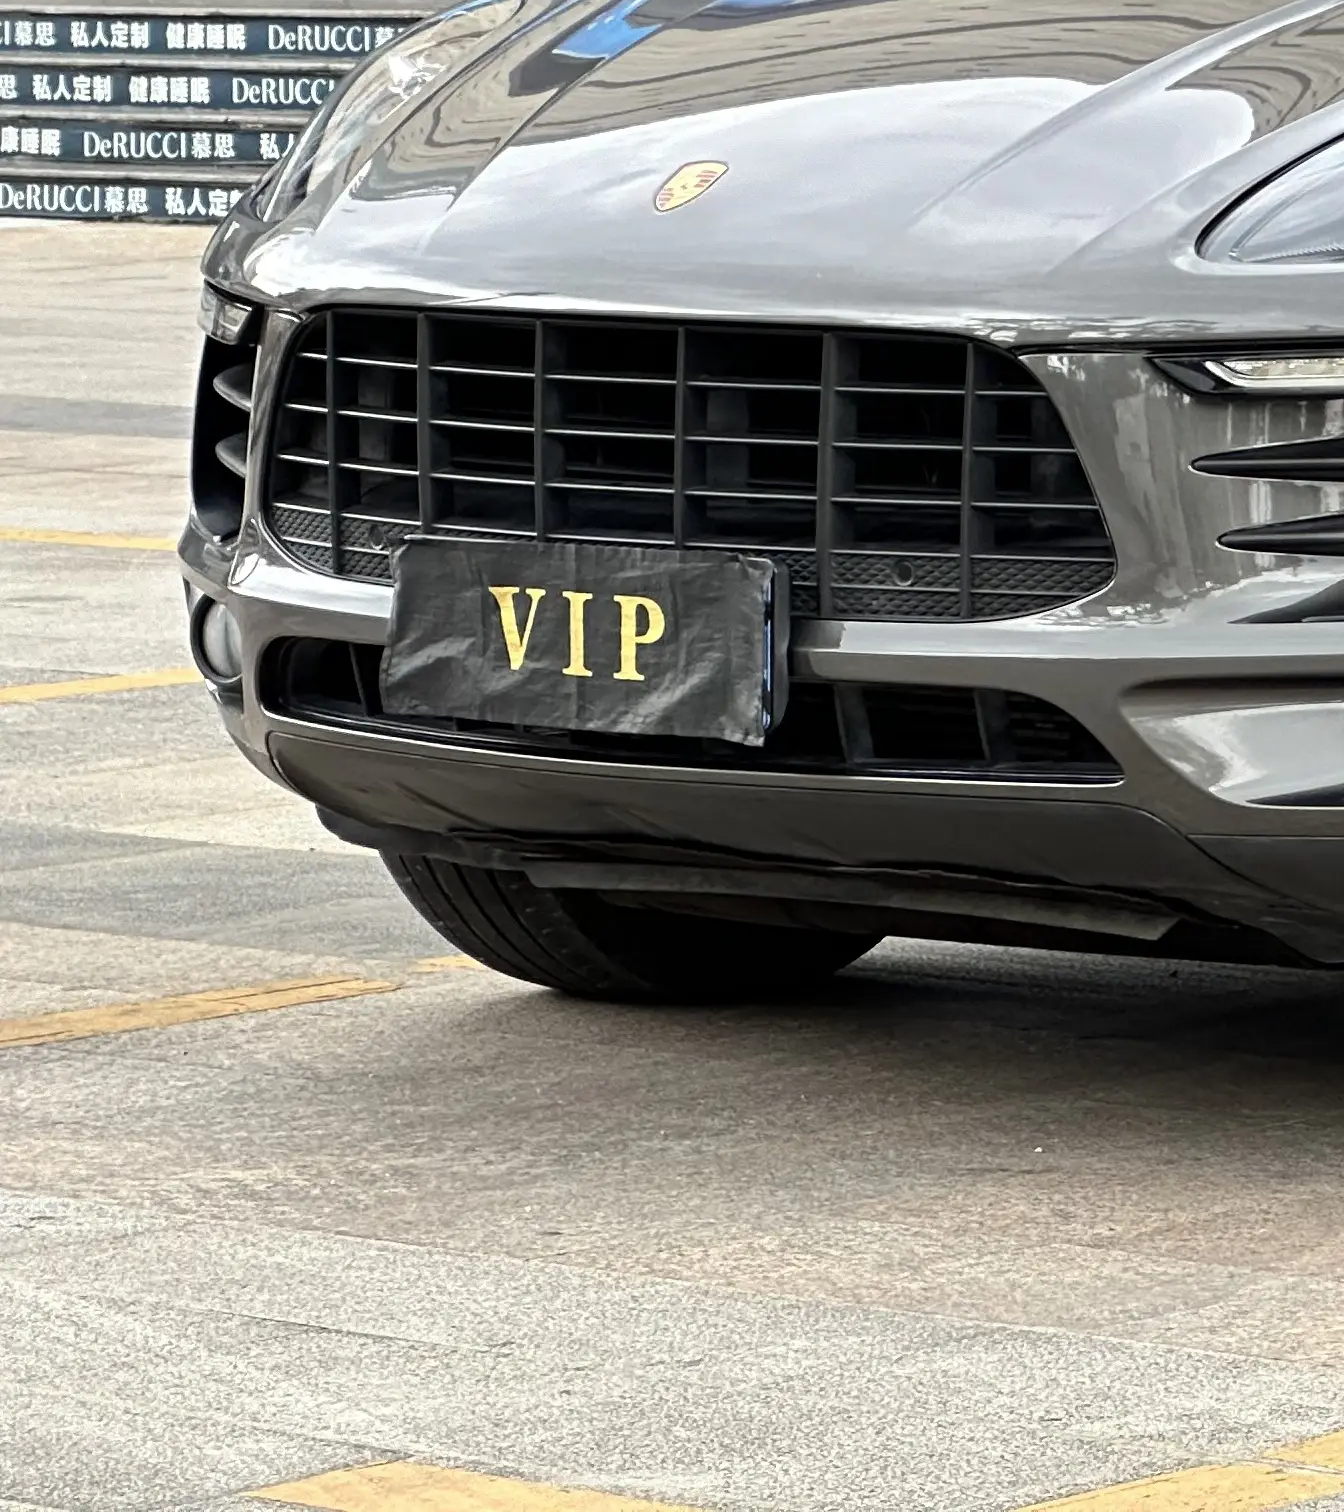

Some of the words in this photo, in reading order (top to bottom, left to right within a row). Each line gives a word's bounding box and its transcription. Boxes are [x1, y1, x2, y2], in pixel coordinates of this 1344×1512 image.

[14, 21, 56, 46] 慕思
[70, 21, 149, 49] 私人定制
[166, 22, 246, 50] 健康睡眠
[268, 24, 370, 51] DeRUCCI
[375, 26, 404, 48] 慕
[32, 74, 112, 102] 私人定制
[129, 76, 210, 104] 健康睡眠
[83, 131, 186, 158] DeRUCCI
[191, 132, 236, 159] 慕思
[0, 183, 100, 212] DeRUCCI
[104, 186, 148, 213] 慕思
[489, 586, 666, 682] VIP
